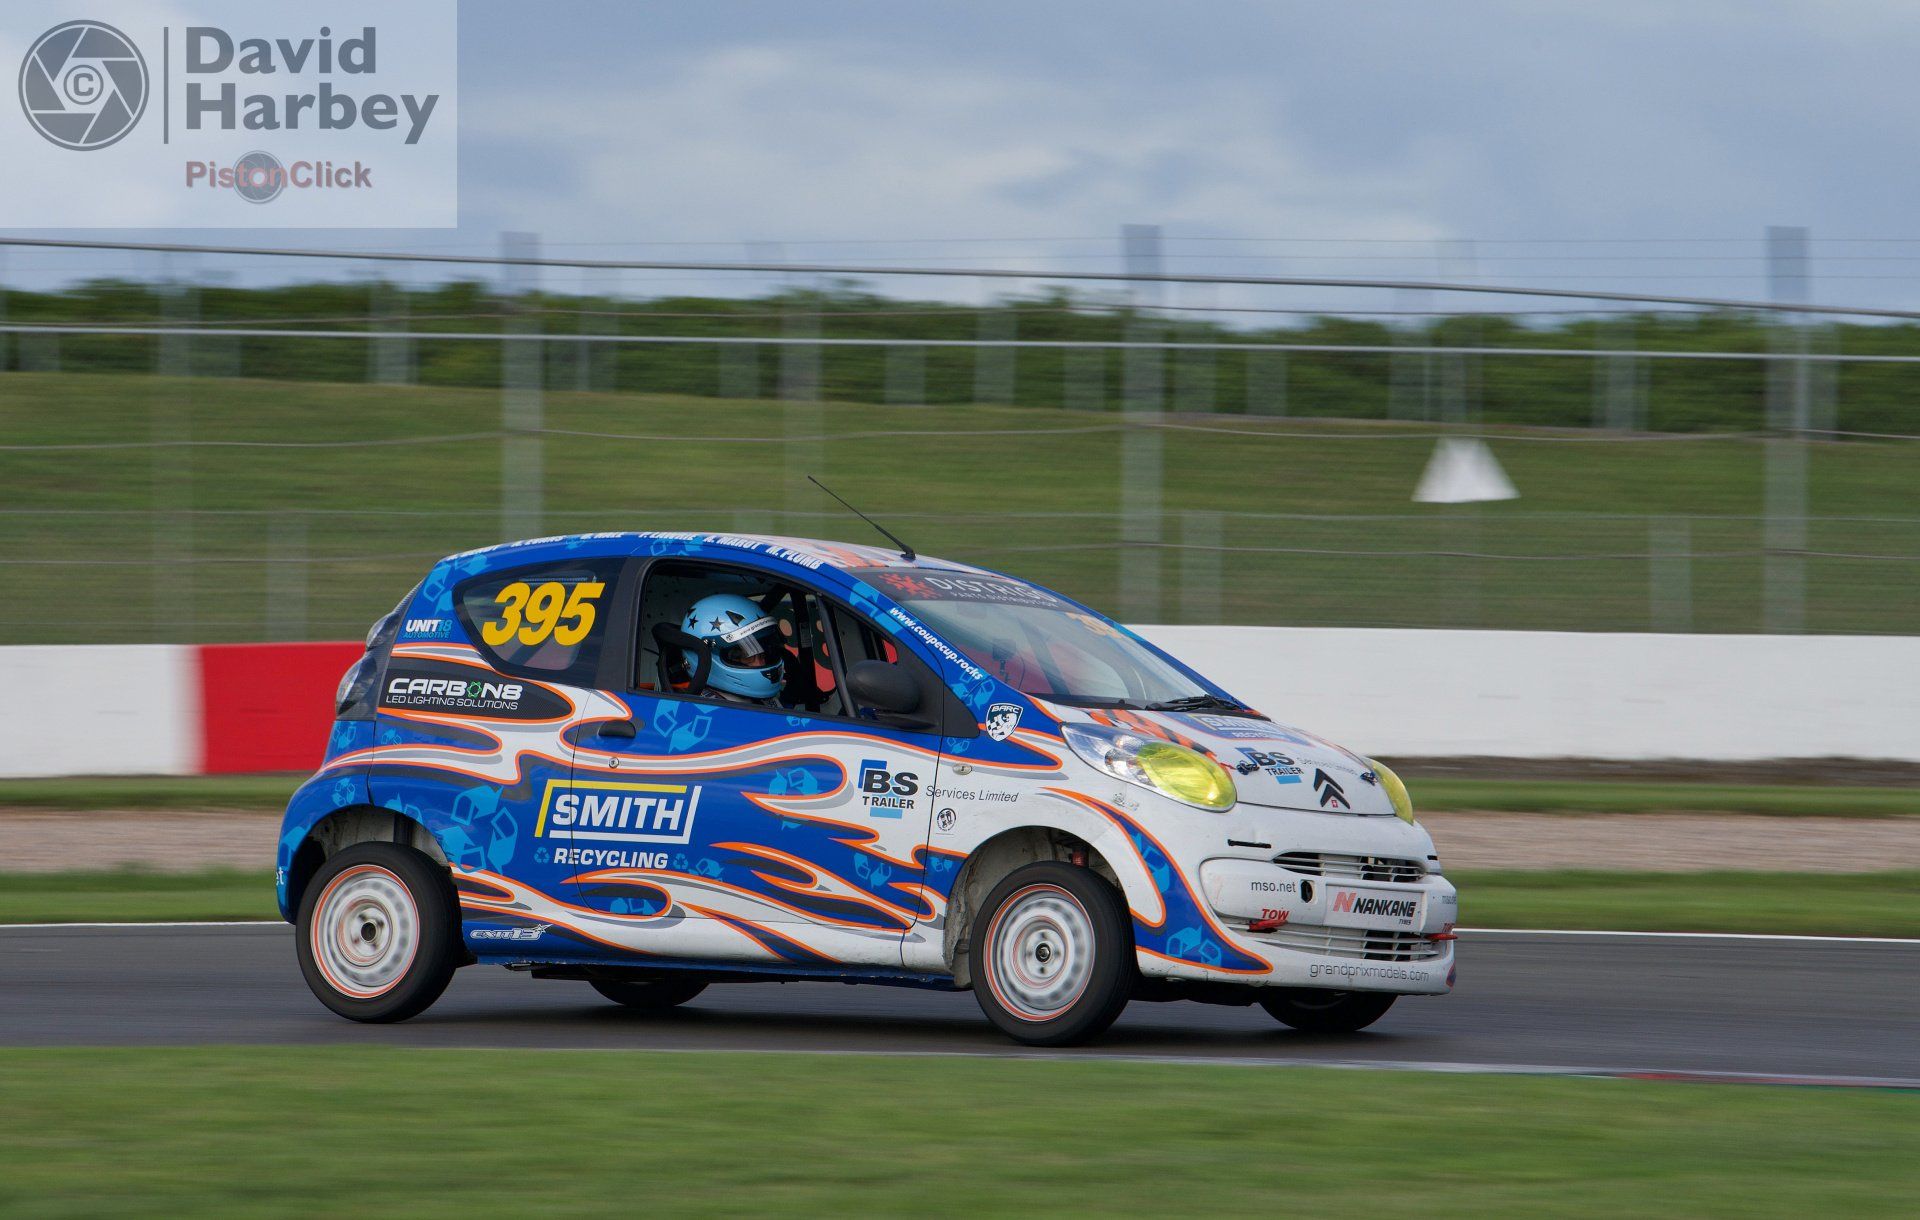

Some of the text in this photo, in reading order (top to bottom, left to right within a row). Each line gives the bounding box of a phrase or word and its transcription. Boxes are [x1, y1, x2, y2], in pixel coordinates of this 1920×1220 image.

[482, 581, 606, 647] 395
[889, 607, 984, 680] www.coupecup.rocks
[385, 695, 519, 710] LED LIGHTING SOLUTIONS
[991, 705, 1020, 714] BARC
[1253, 751, 1295, 767] BS
[1264, 767, 1304, 777] TRAILER
[862, 769, 919, 796] BS
[862, 796, 915, 810] TRAILER
[926, 785, 1020, 803] Services Limited
[552, 794, 685, 831] SMITH
[554, 848, 669, 869] RECYCLING
[1251, 880, 1297, 893] mso.net
[1261, 908, 1290, 921] TOW
[1353, 897, 1417, 918] NANKANG
[1310, 963, 1430, 982] grandprixmodels.com
